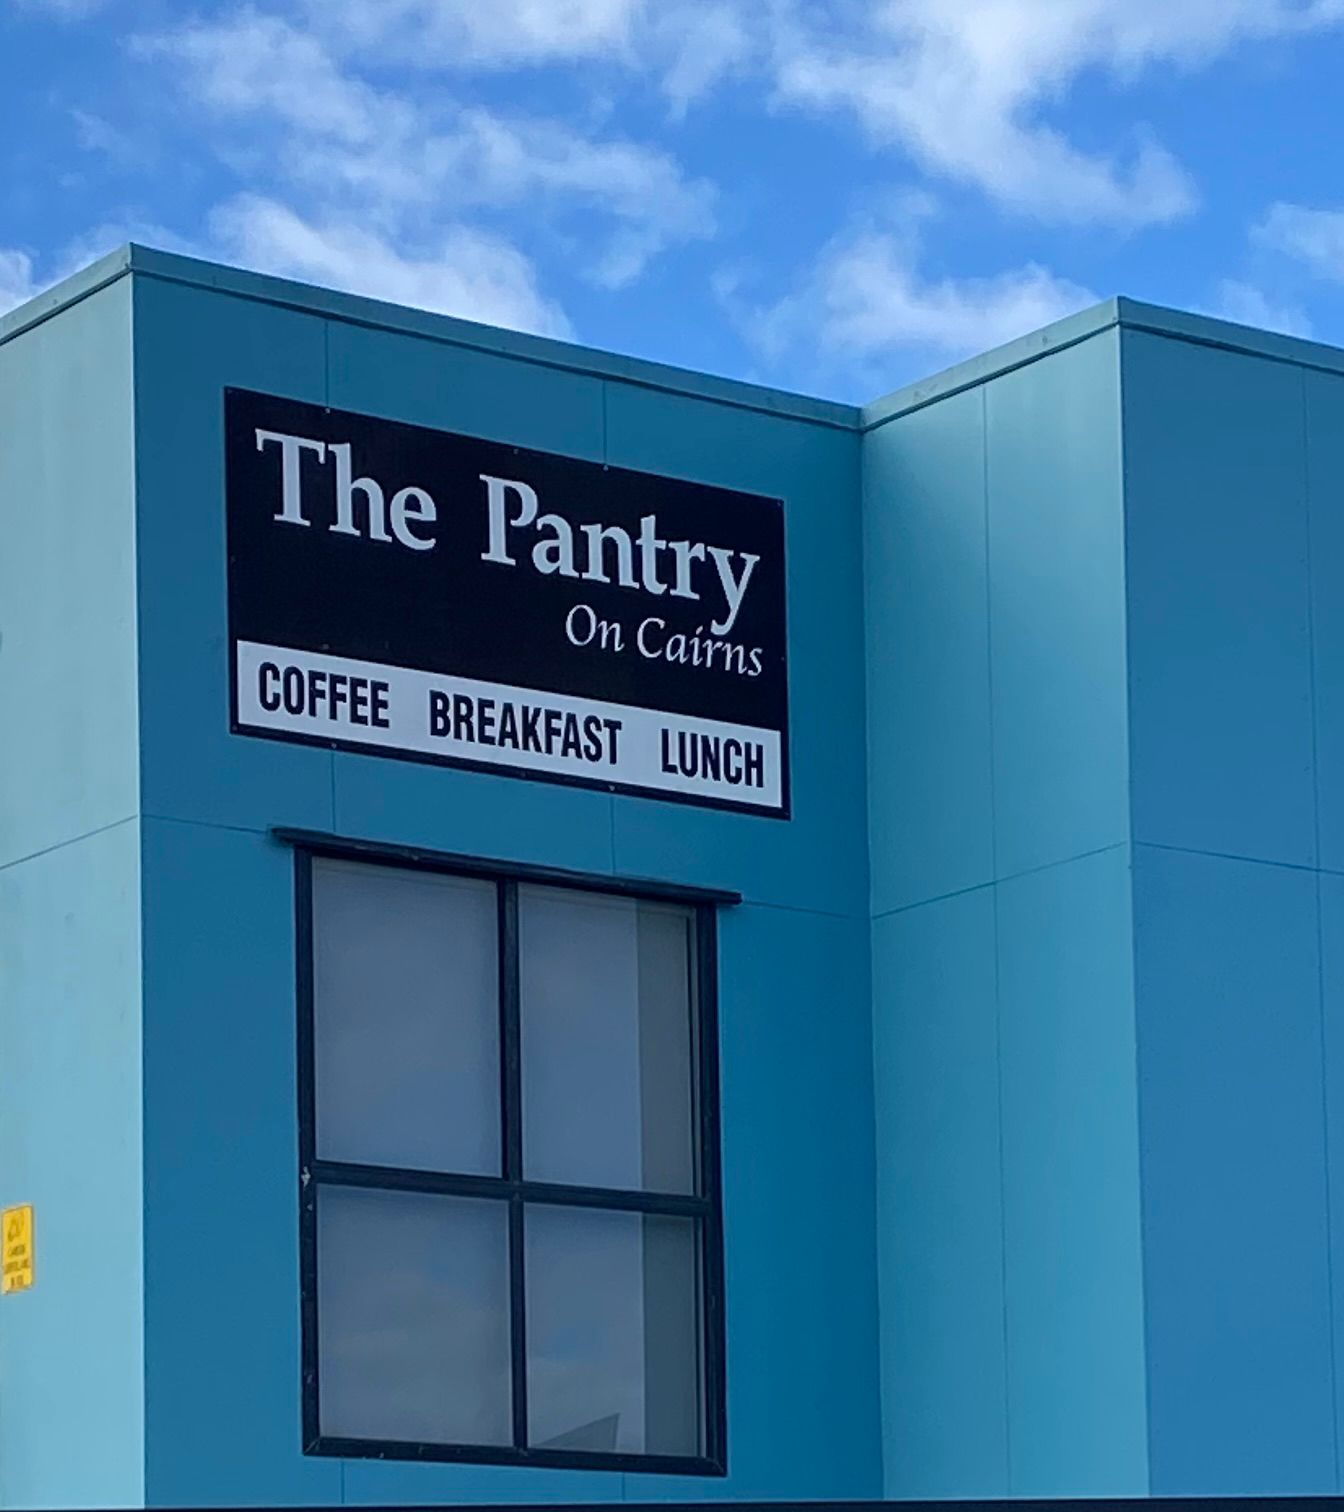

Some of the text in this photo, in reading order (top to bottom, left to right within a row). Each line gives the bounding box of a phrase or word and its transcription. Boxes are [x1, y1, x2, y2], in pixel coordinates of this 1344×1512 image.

[256, 429, 760, 636] The Pantry
[565, 604, 763, 677] On Cairns
[258, 661, 764, 789] COFFEE BREAKFAST LUNCH
